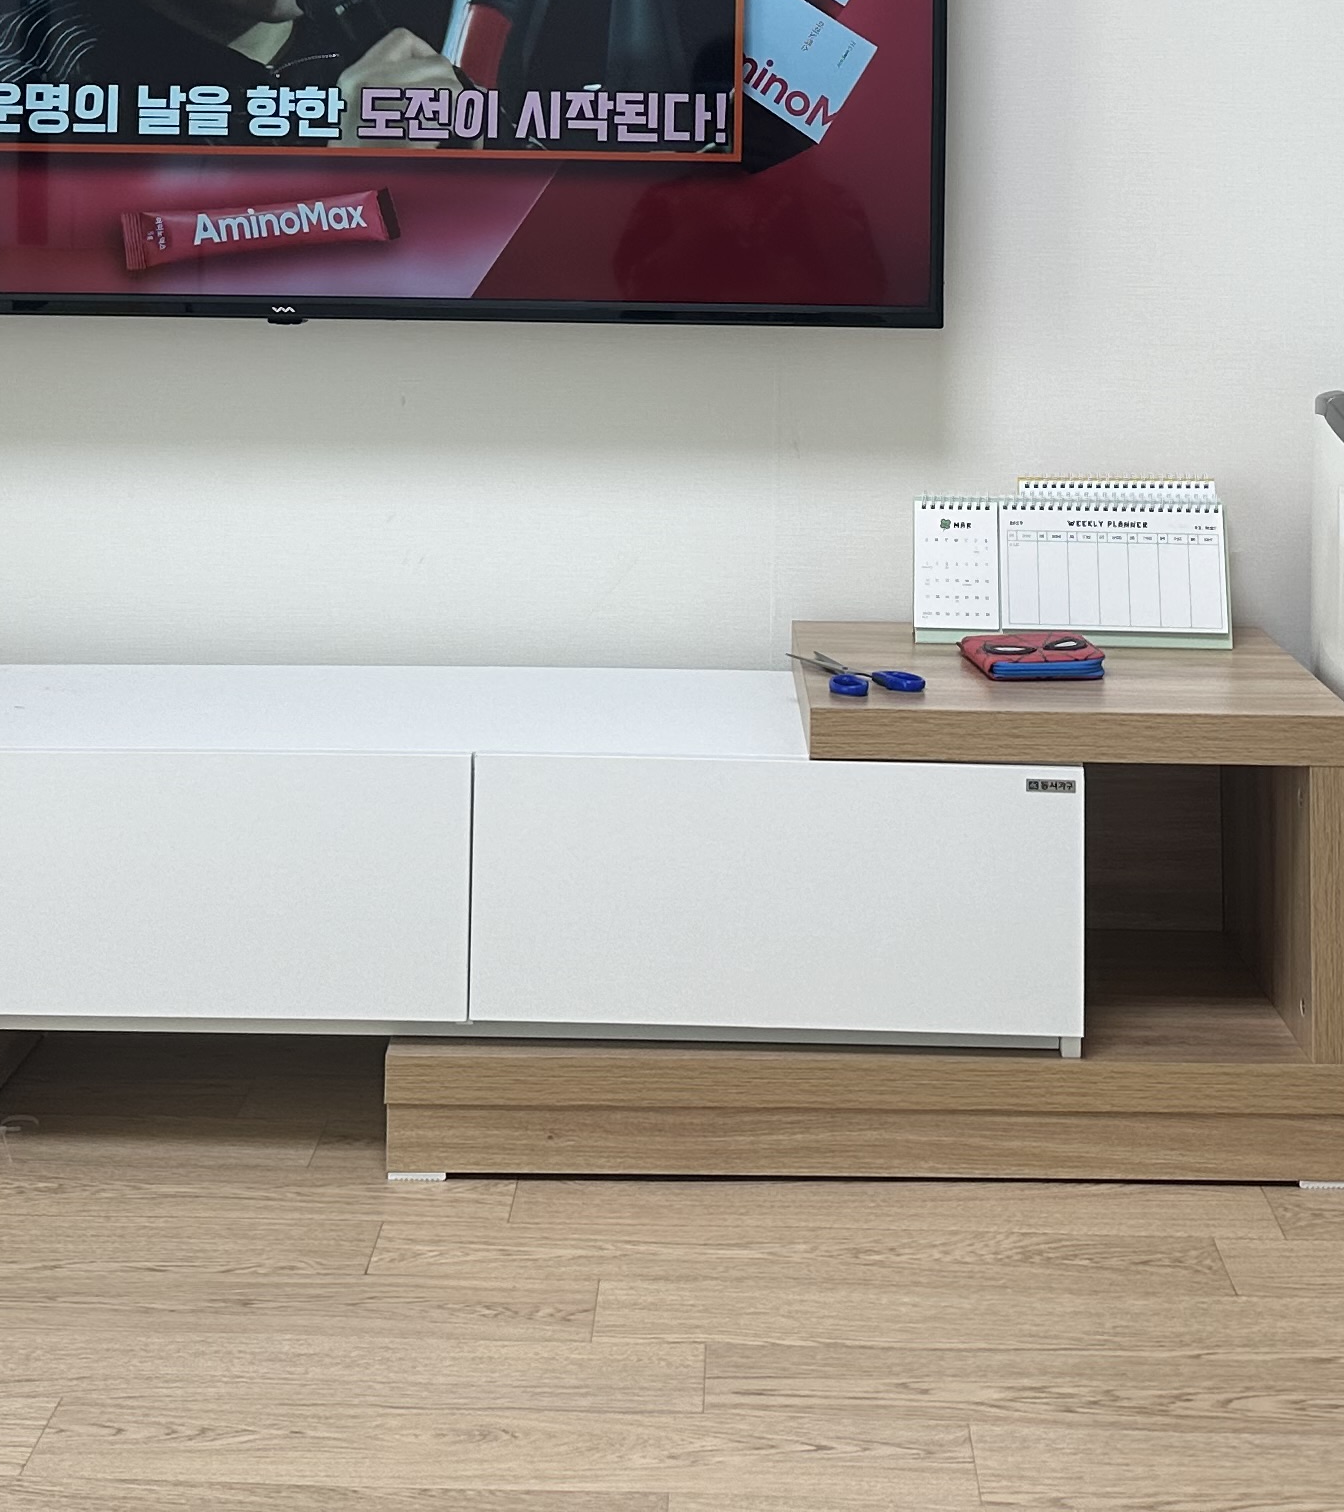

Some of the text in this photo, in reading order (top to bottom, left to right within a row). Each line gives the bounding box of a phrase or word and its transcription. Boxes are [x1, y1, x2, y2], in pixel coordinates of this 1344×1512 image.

[137, 84, 233, 137] 날을
[246, 85, 346, 138] 향한
[358, 88, 498, 140] 도전이
[514, 90, 727, 144] 시작된다!
[193, 201, 368, 246] AminoMax
[1107, 520, 1148, 528] PLANNER
